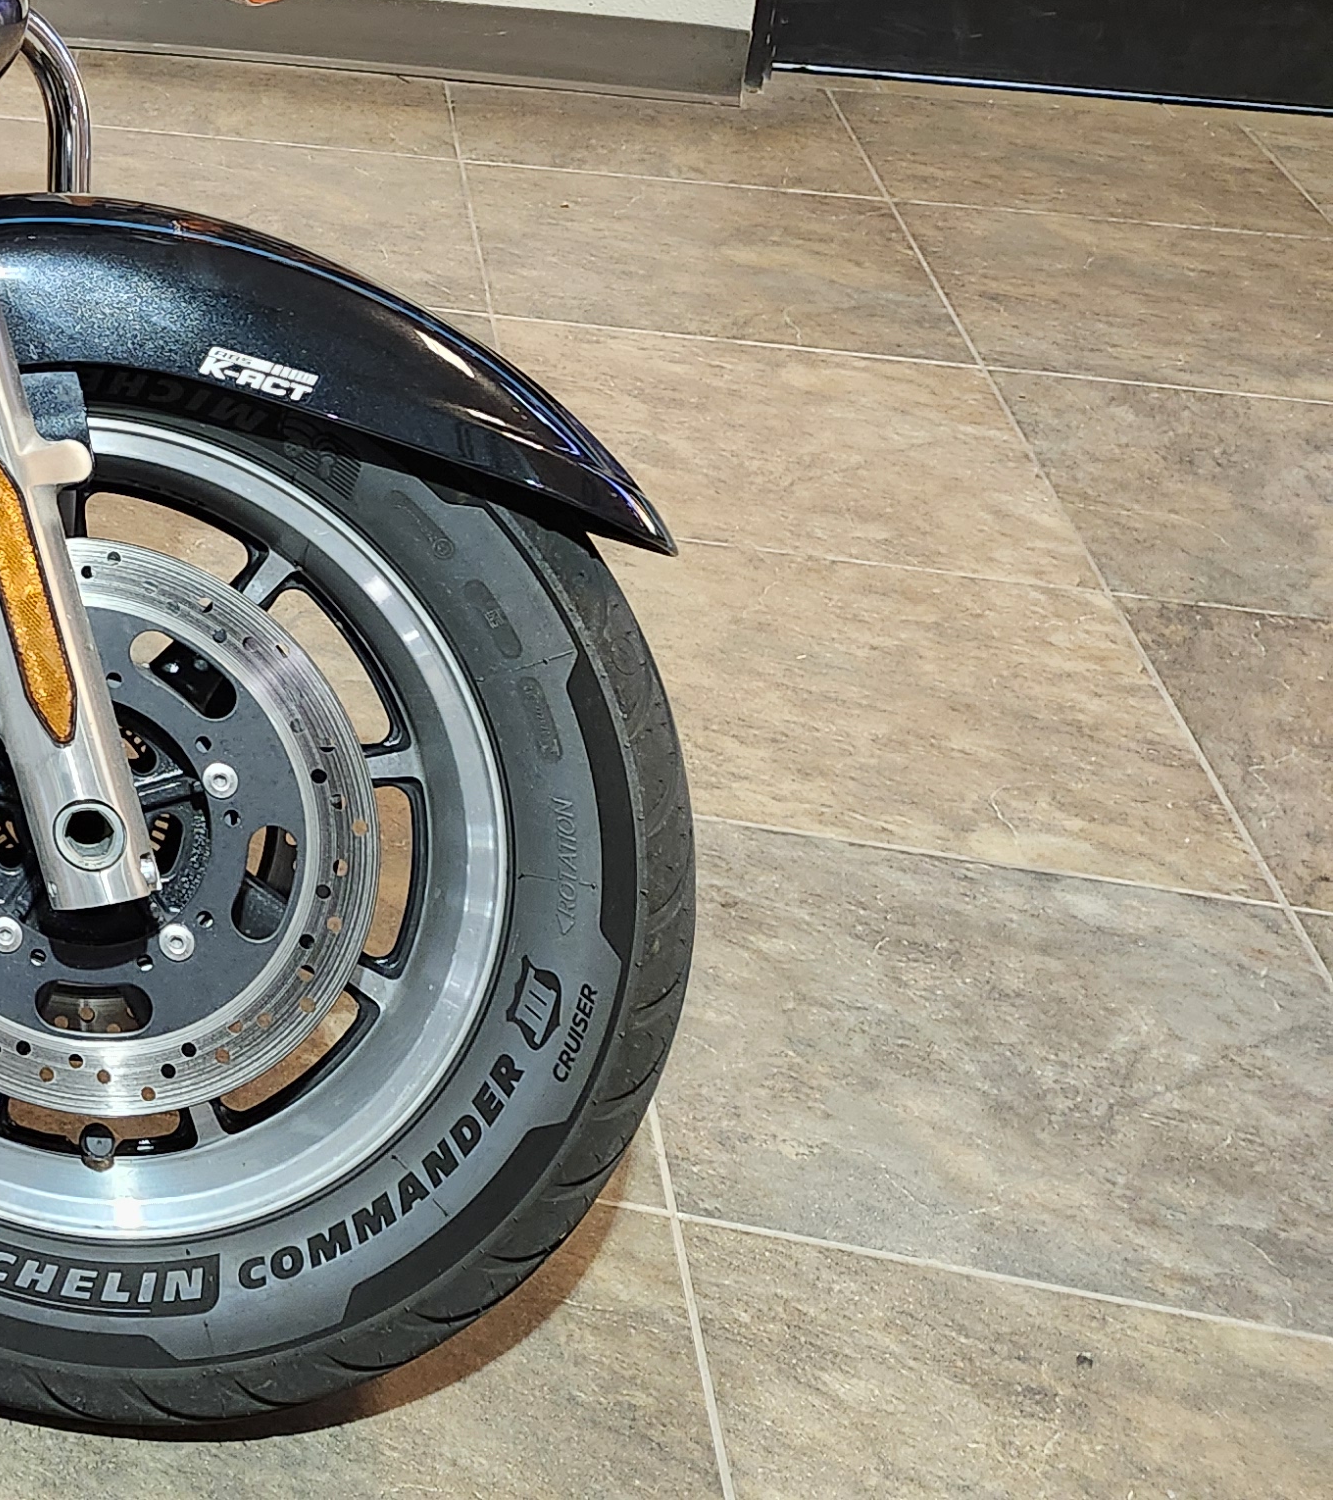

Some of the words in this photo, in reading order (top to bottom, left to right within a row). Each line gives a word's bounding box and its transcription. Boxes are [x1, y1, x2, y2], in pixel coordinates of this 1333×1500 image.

[199, 356, 314, 402] K-ACT
[555, 798, 576, 914] ROTATION
[551, 982, 600, 1085] CRUISER
[237, 1050, 526, 1292] COMMANDER
